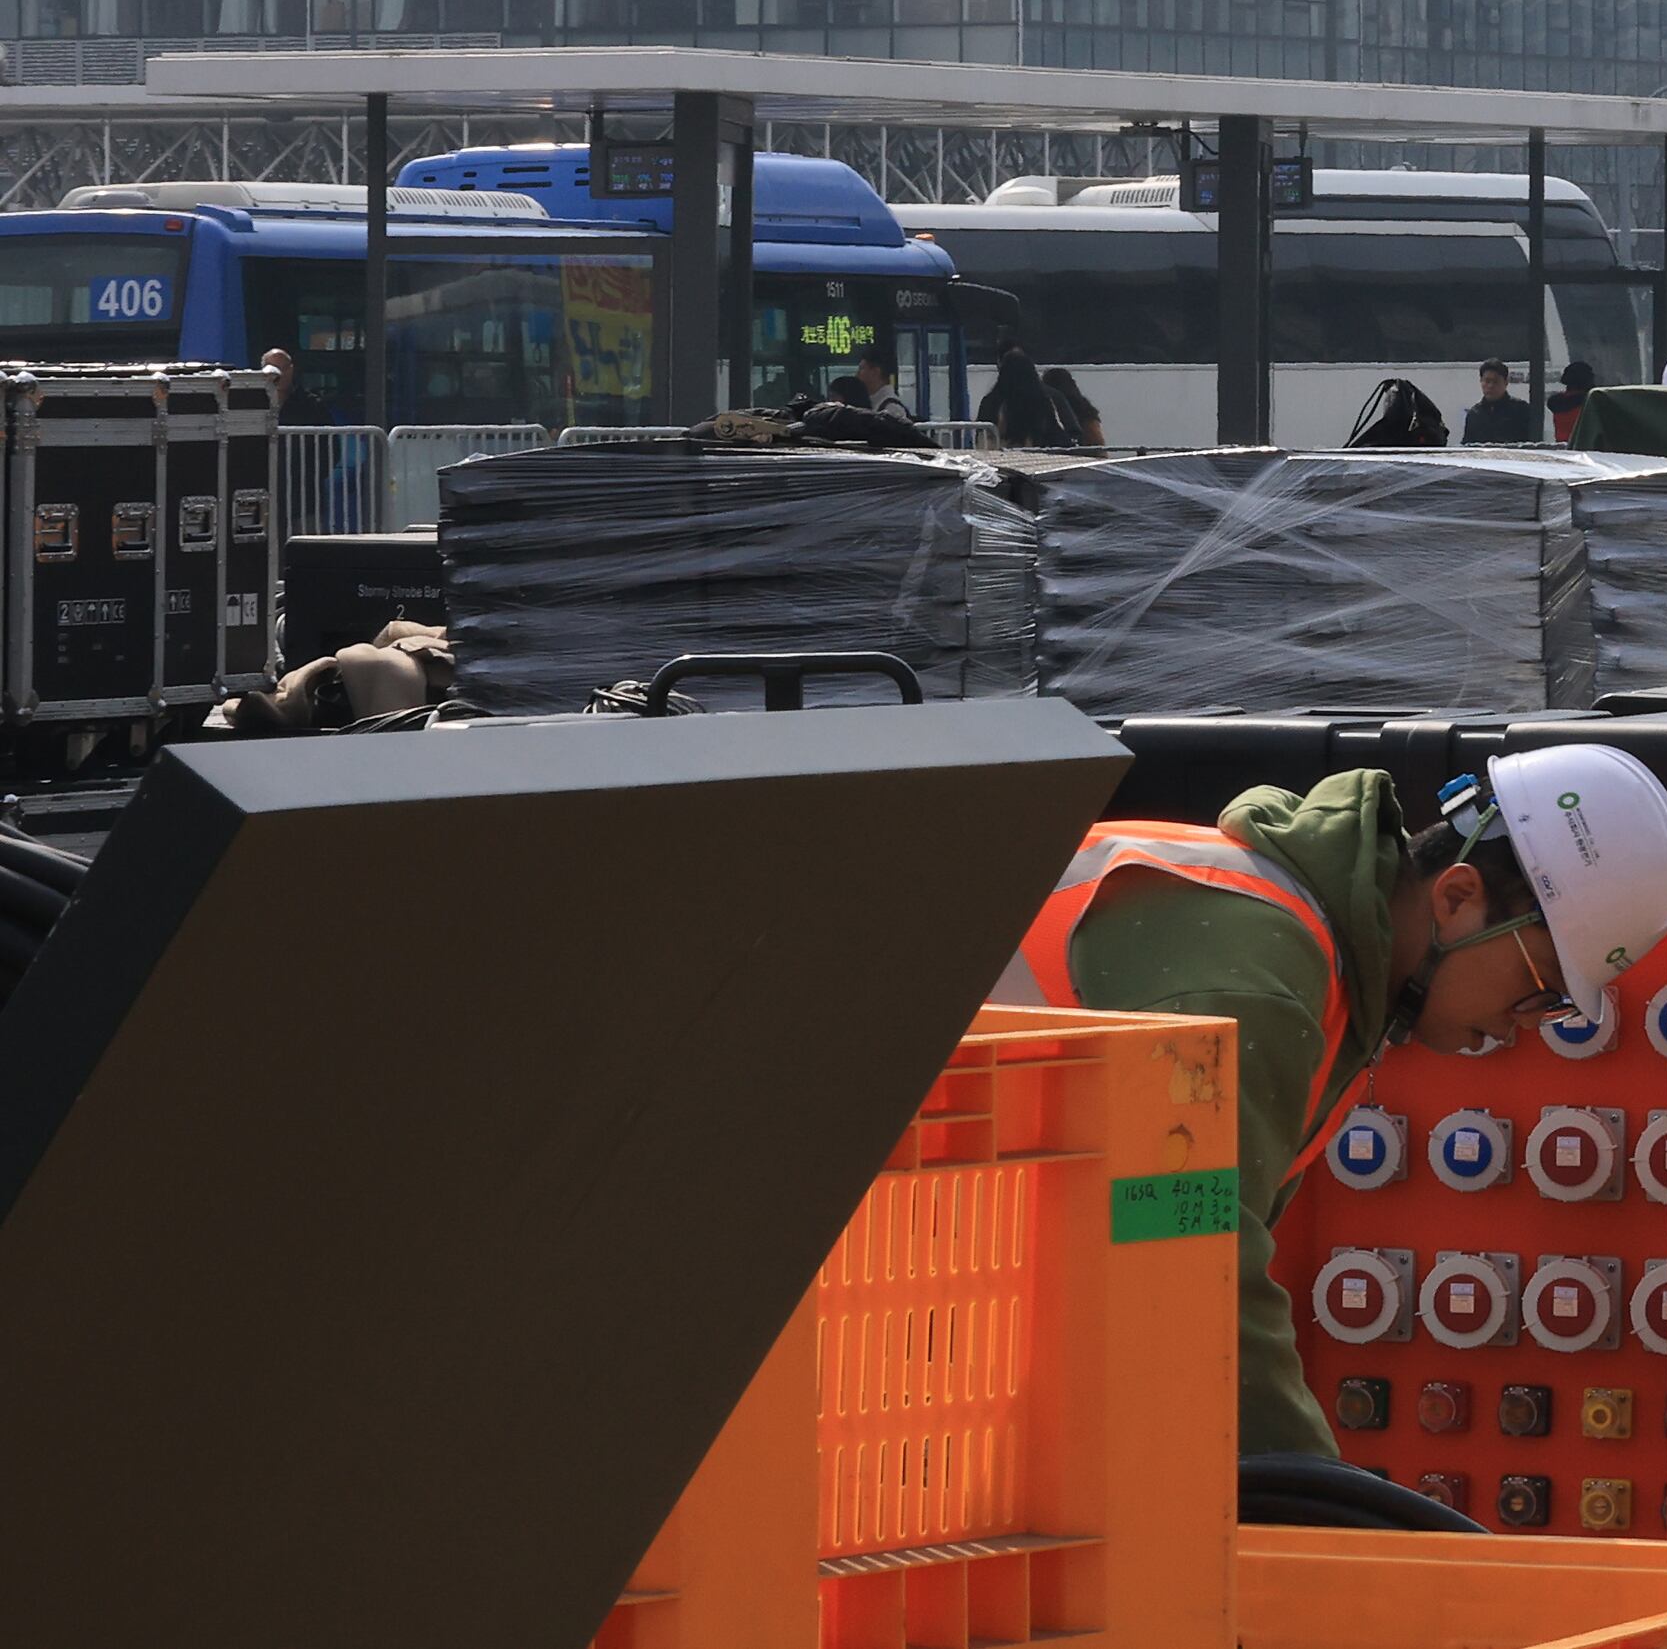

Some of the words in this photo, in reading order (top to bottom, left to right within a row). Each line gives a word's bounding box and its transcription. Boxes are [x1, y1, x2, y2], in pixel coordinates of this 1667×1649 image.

[826, 281, 844, 298] 1511
[98, 279, 163, 318] 406
[827, 316, 851, 354] 406
[357, 583, 390, 600] Stormy
[423, 585, 441, 599] Bar
[396, 603, 405, 620] 2
